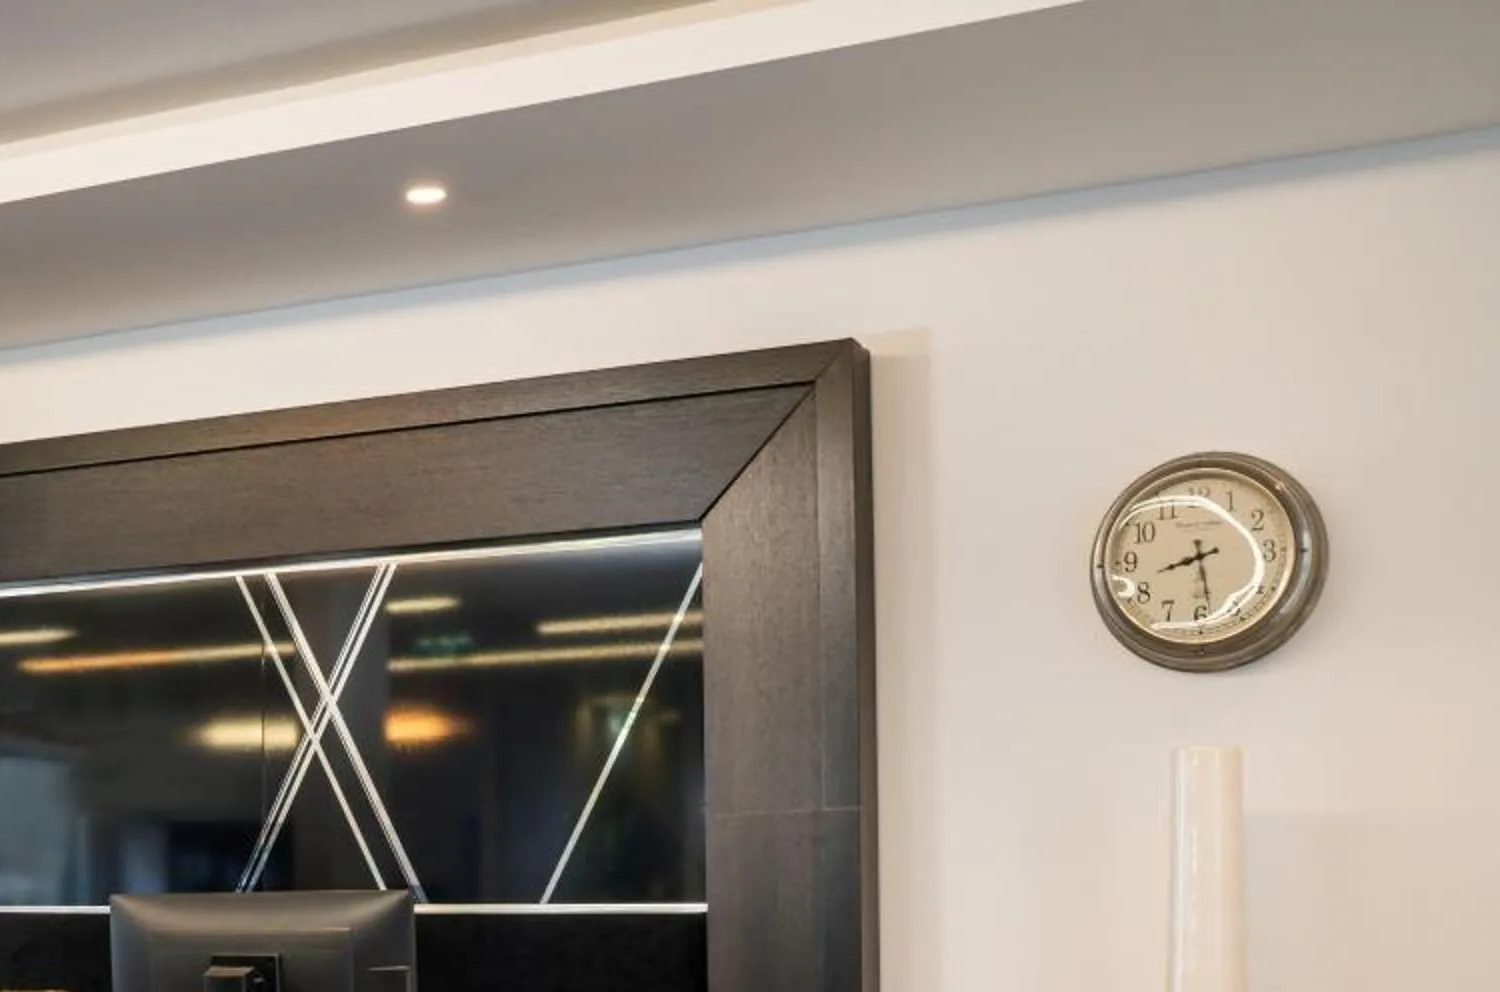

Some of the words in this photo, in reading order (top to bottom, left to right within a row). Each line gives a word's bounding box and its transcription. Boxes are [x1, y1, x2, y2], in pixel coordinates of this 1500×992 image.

[1226, 490, 1234, 512] 1
[1251, 509, 1265, 531] 2
[1134, 520, 1156, 545] 10
[1263, 539, 1276, 561] 3
[1124, 551, 1138, 573] 9
[1137, 581, 1151, 604] 8
[1161, 600, 1175, 622] 7
[1193, 605, 1207, 623] 6
